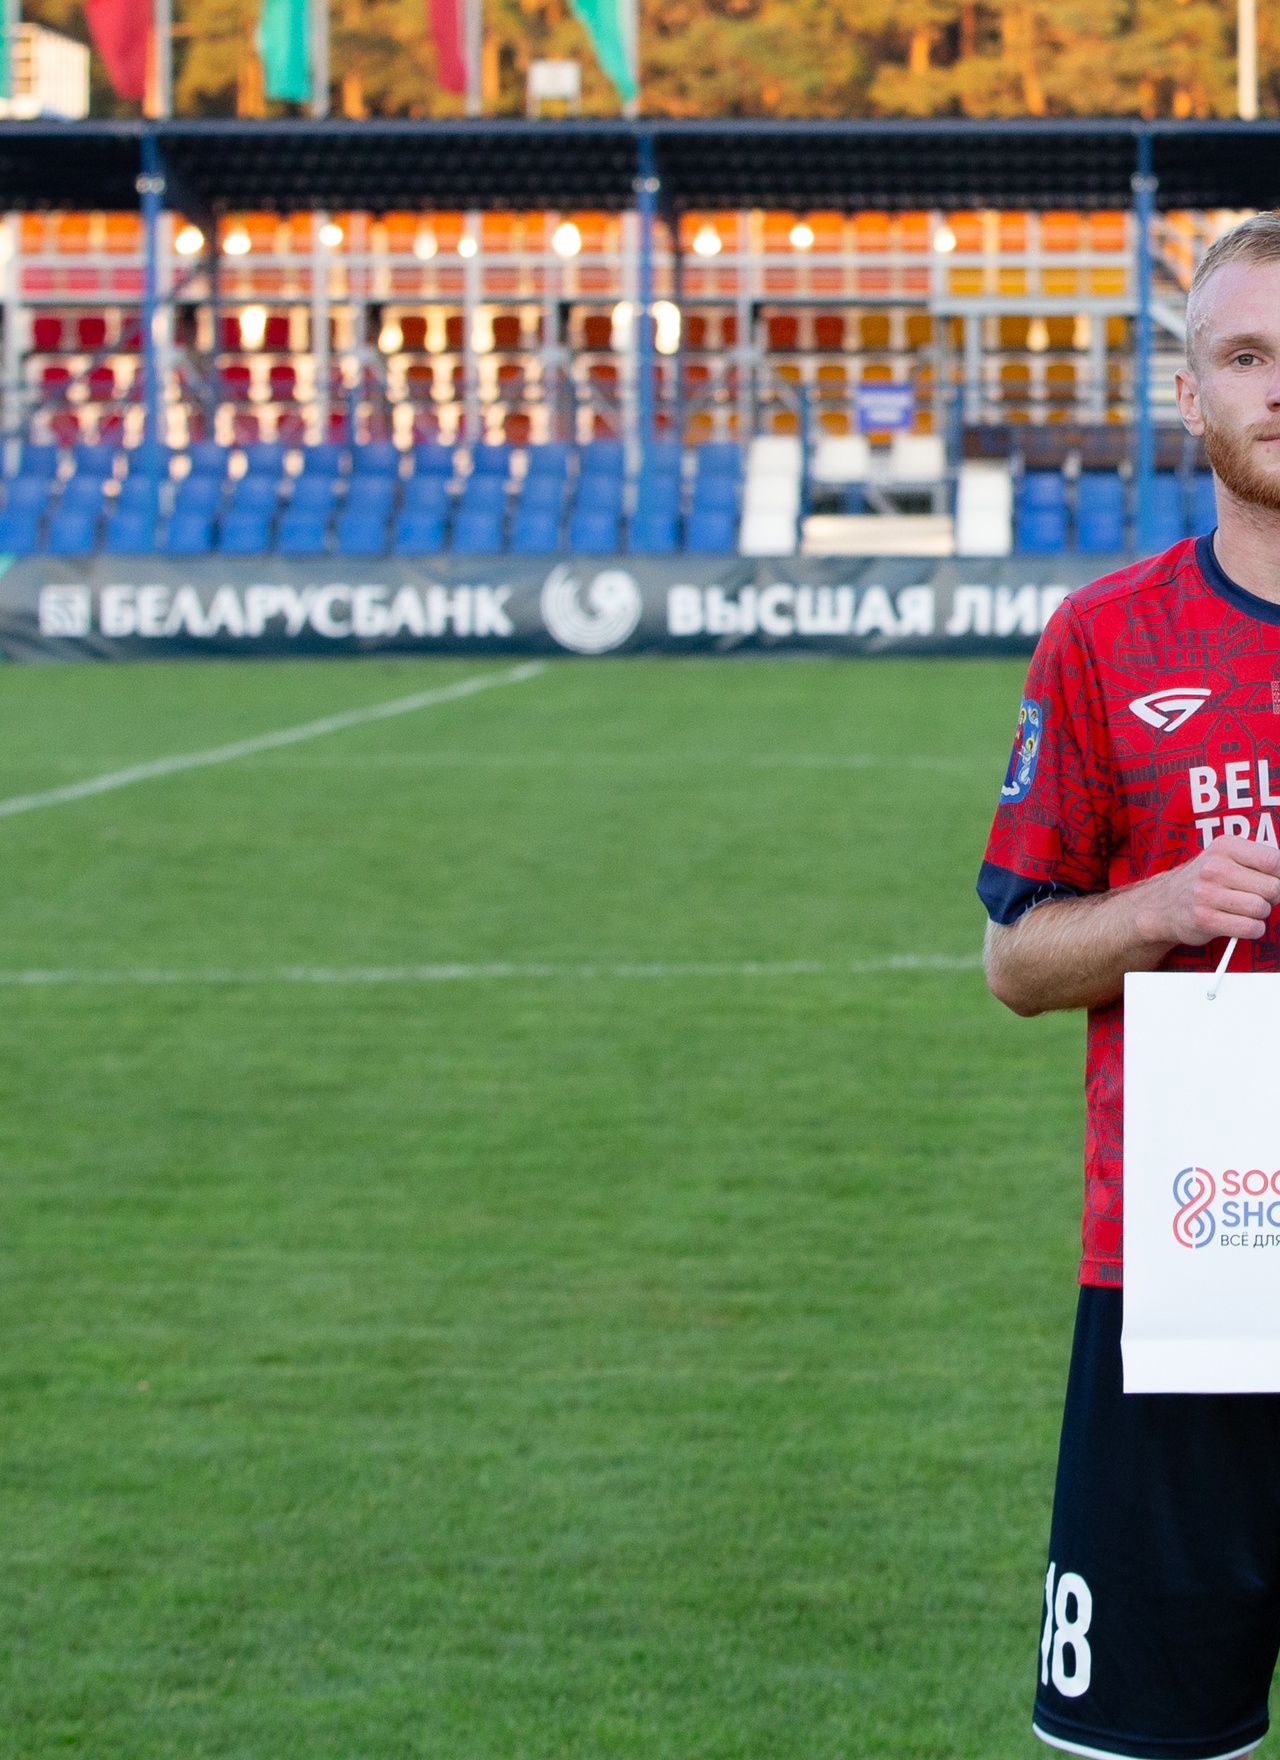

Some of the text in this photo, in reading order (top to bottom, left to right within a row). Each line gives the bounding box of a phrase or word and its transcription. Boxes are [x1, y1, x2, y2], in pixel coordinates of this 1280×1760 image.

[101, 584, 513, 638] БЕЛАРУСБАНК
[667, 584, 935, 637] ВЫСШАЯ
[1220, 1232, 1249, 1247] ВСЁ
[1041, 1561, 1092, 1698] 18
